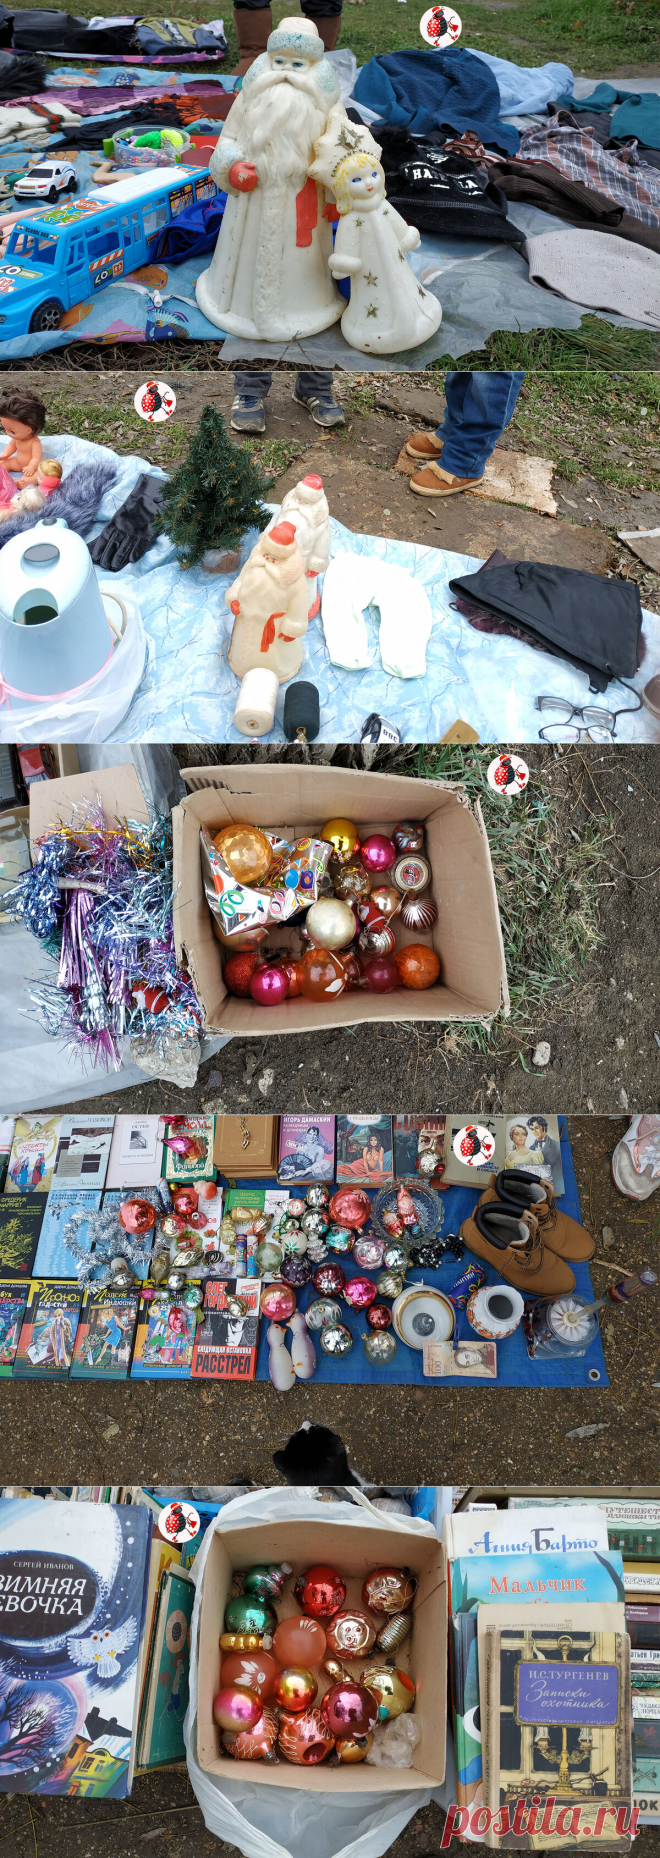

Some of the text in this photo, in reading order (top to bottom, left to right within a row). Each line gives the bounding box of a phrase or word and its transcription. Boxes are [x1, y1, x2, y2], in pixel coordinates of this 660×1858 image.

[205, 1281, 227, 1294] ОЛЕГ
[197, 1345, 252, 1355] СЛЕДУЮЩАЯ ОСТАНОВКА
[195, 1353, 251, 1375] РАССТРЕЛ
[530, 1527, 598, 1552] Барто
[43, 1562, 74, 1570] ИВАНОВ
[489, 1576, 587, 1595] Мальчик
[525, 1680, 592, 1702] Записки
[540, 1697, 610, 1709] охотника
